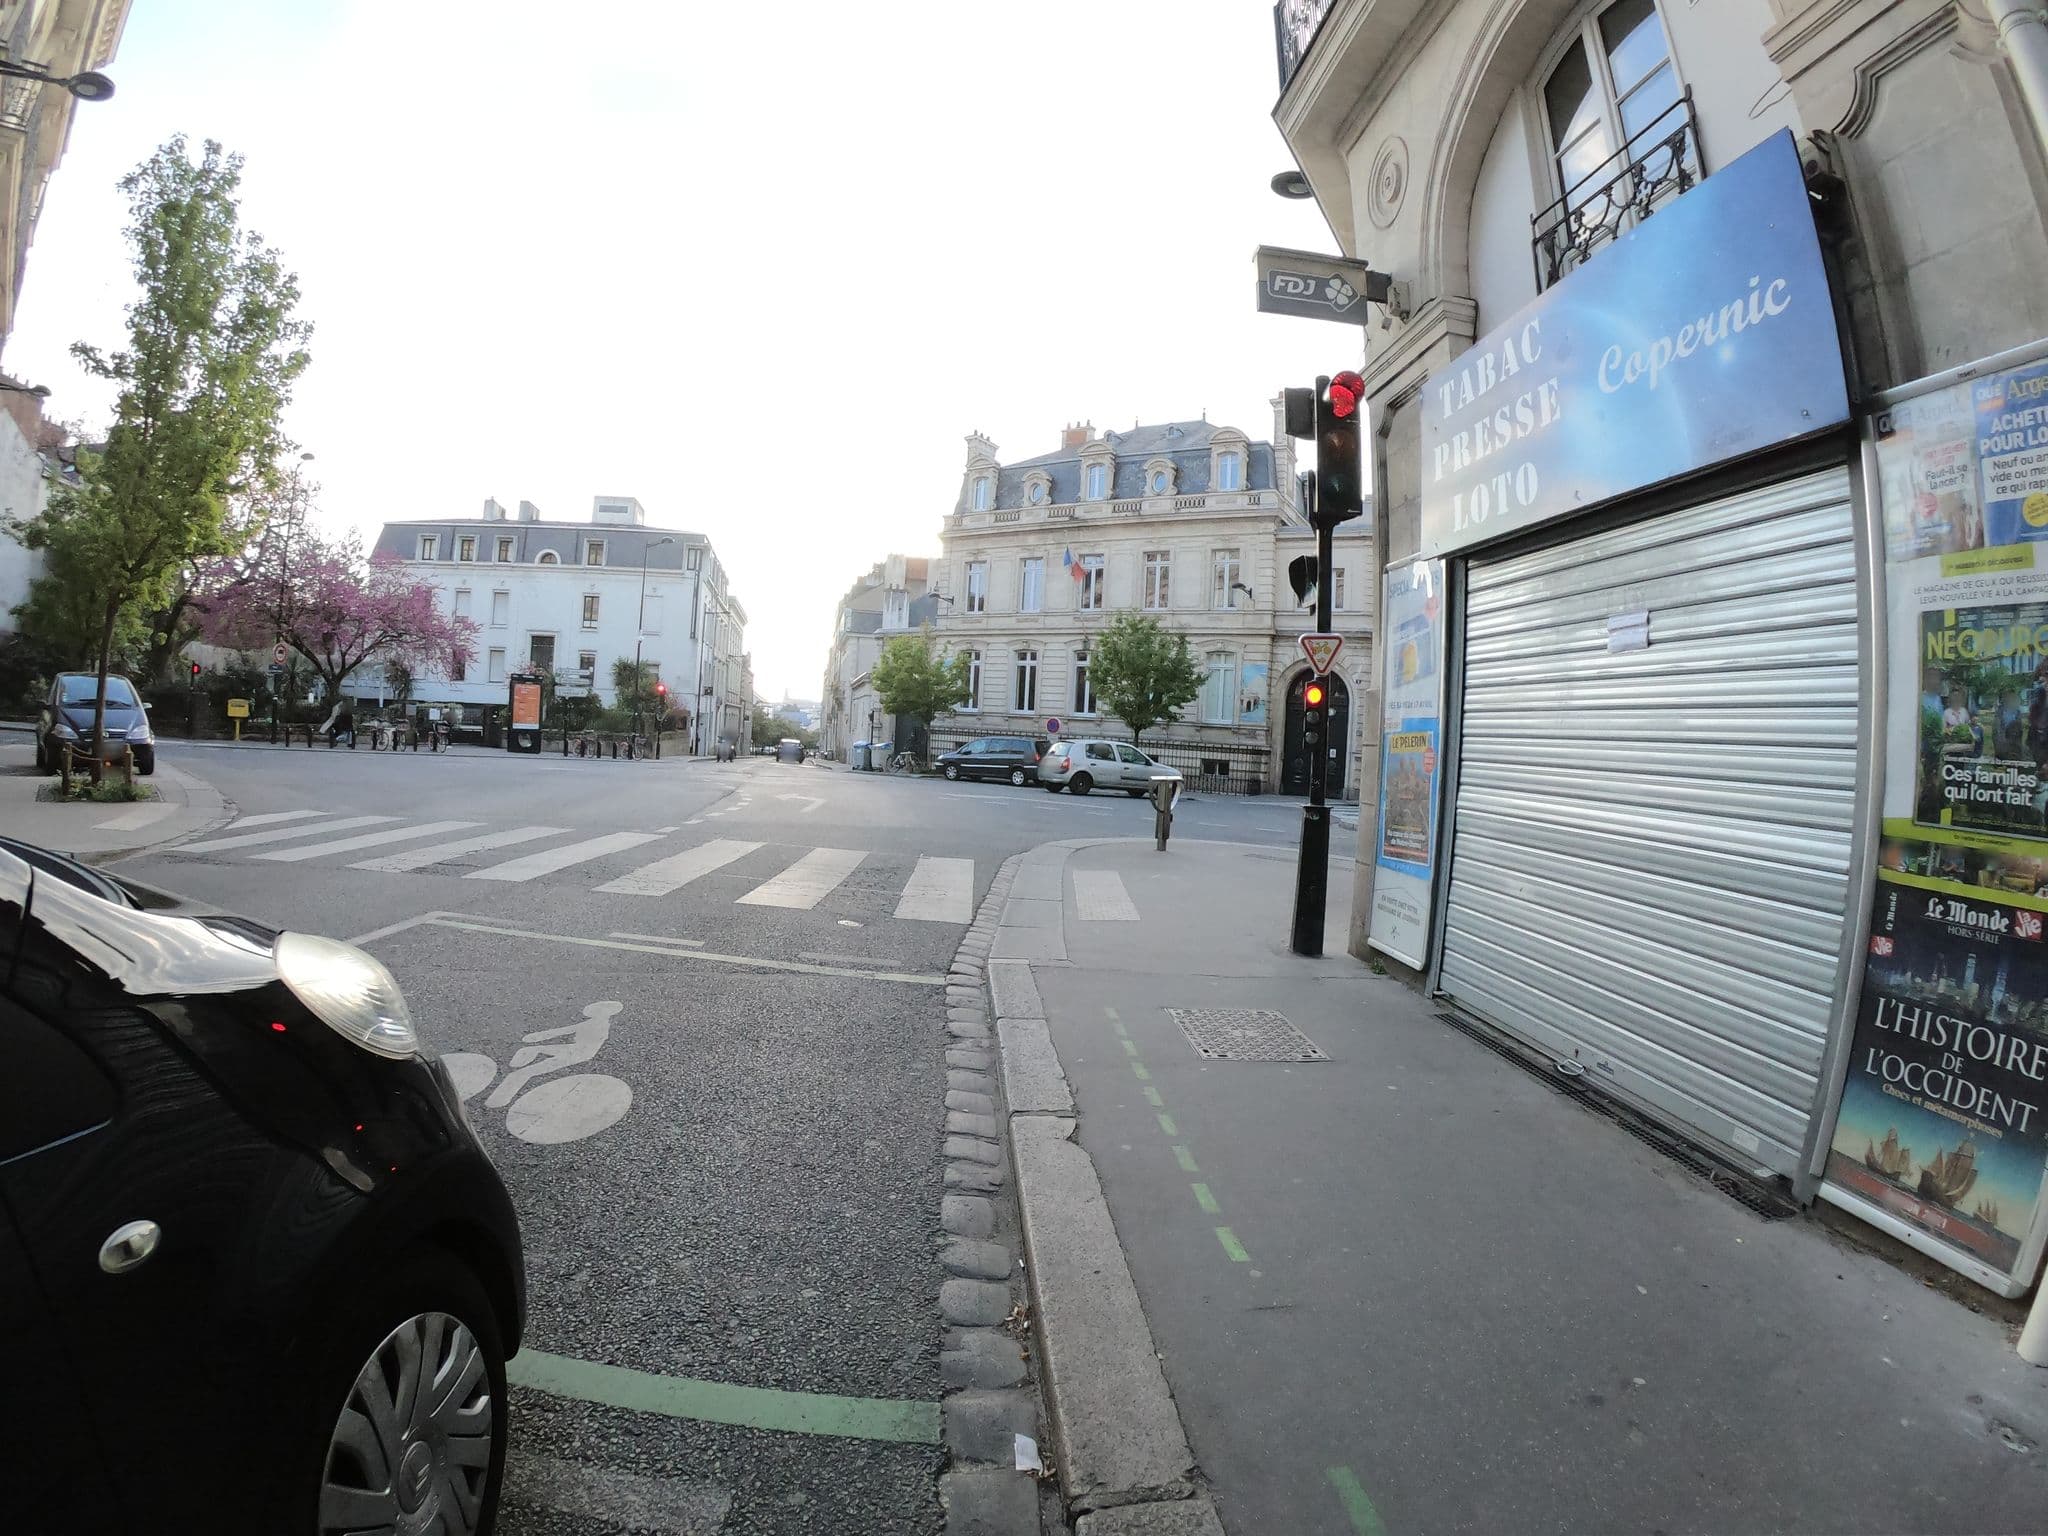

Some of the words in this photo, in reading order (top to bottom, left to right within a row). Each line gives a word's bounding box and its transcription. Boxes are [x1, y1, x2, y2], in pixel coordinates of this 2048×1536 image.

[1273, 275, 1316, 296] FDJ
[1597, 274, 1792, 394] Copernic
[1439, 316, 1542, 420] TABAC
[1432, 376, 1561, 482] PRESSE
[1979, 431, 2025, 457] POUR
[1992, 455, 2019, 470] Neuf
[2020, 456, 2034, 466] ou
[1990, 471, 2012, 483] vide
[2014, 469, 2028, 479] ou
[1996, 485, 2008, 495] ce
[2010, 480, 2028, 494] qui
[1452, 461, 1539, 532] LOTO
[1942, 764, 1973, 782] Ces
[1974, 766, 2038, 788] familles
[1944, 783, 1968, 802] qui
[2005, 786, 2033, 807] fait
[1924, 897, 1945, 919] Le
[1945, 900, 2010, 933] Monde
[1874, 997, 2048, 1081] L'HISTOIRE
[1941, 1052, 1965, 1074] DE
[1864, 1047, 2038, 1133] L'OCCIDENT
